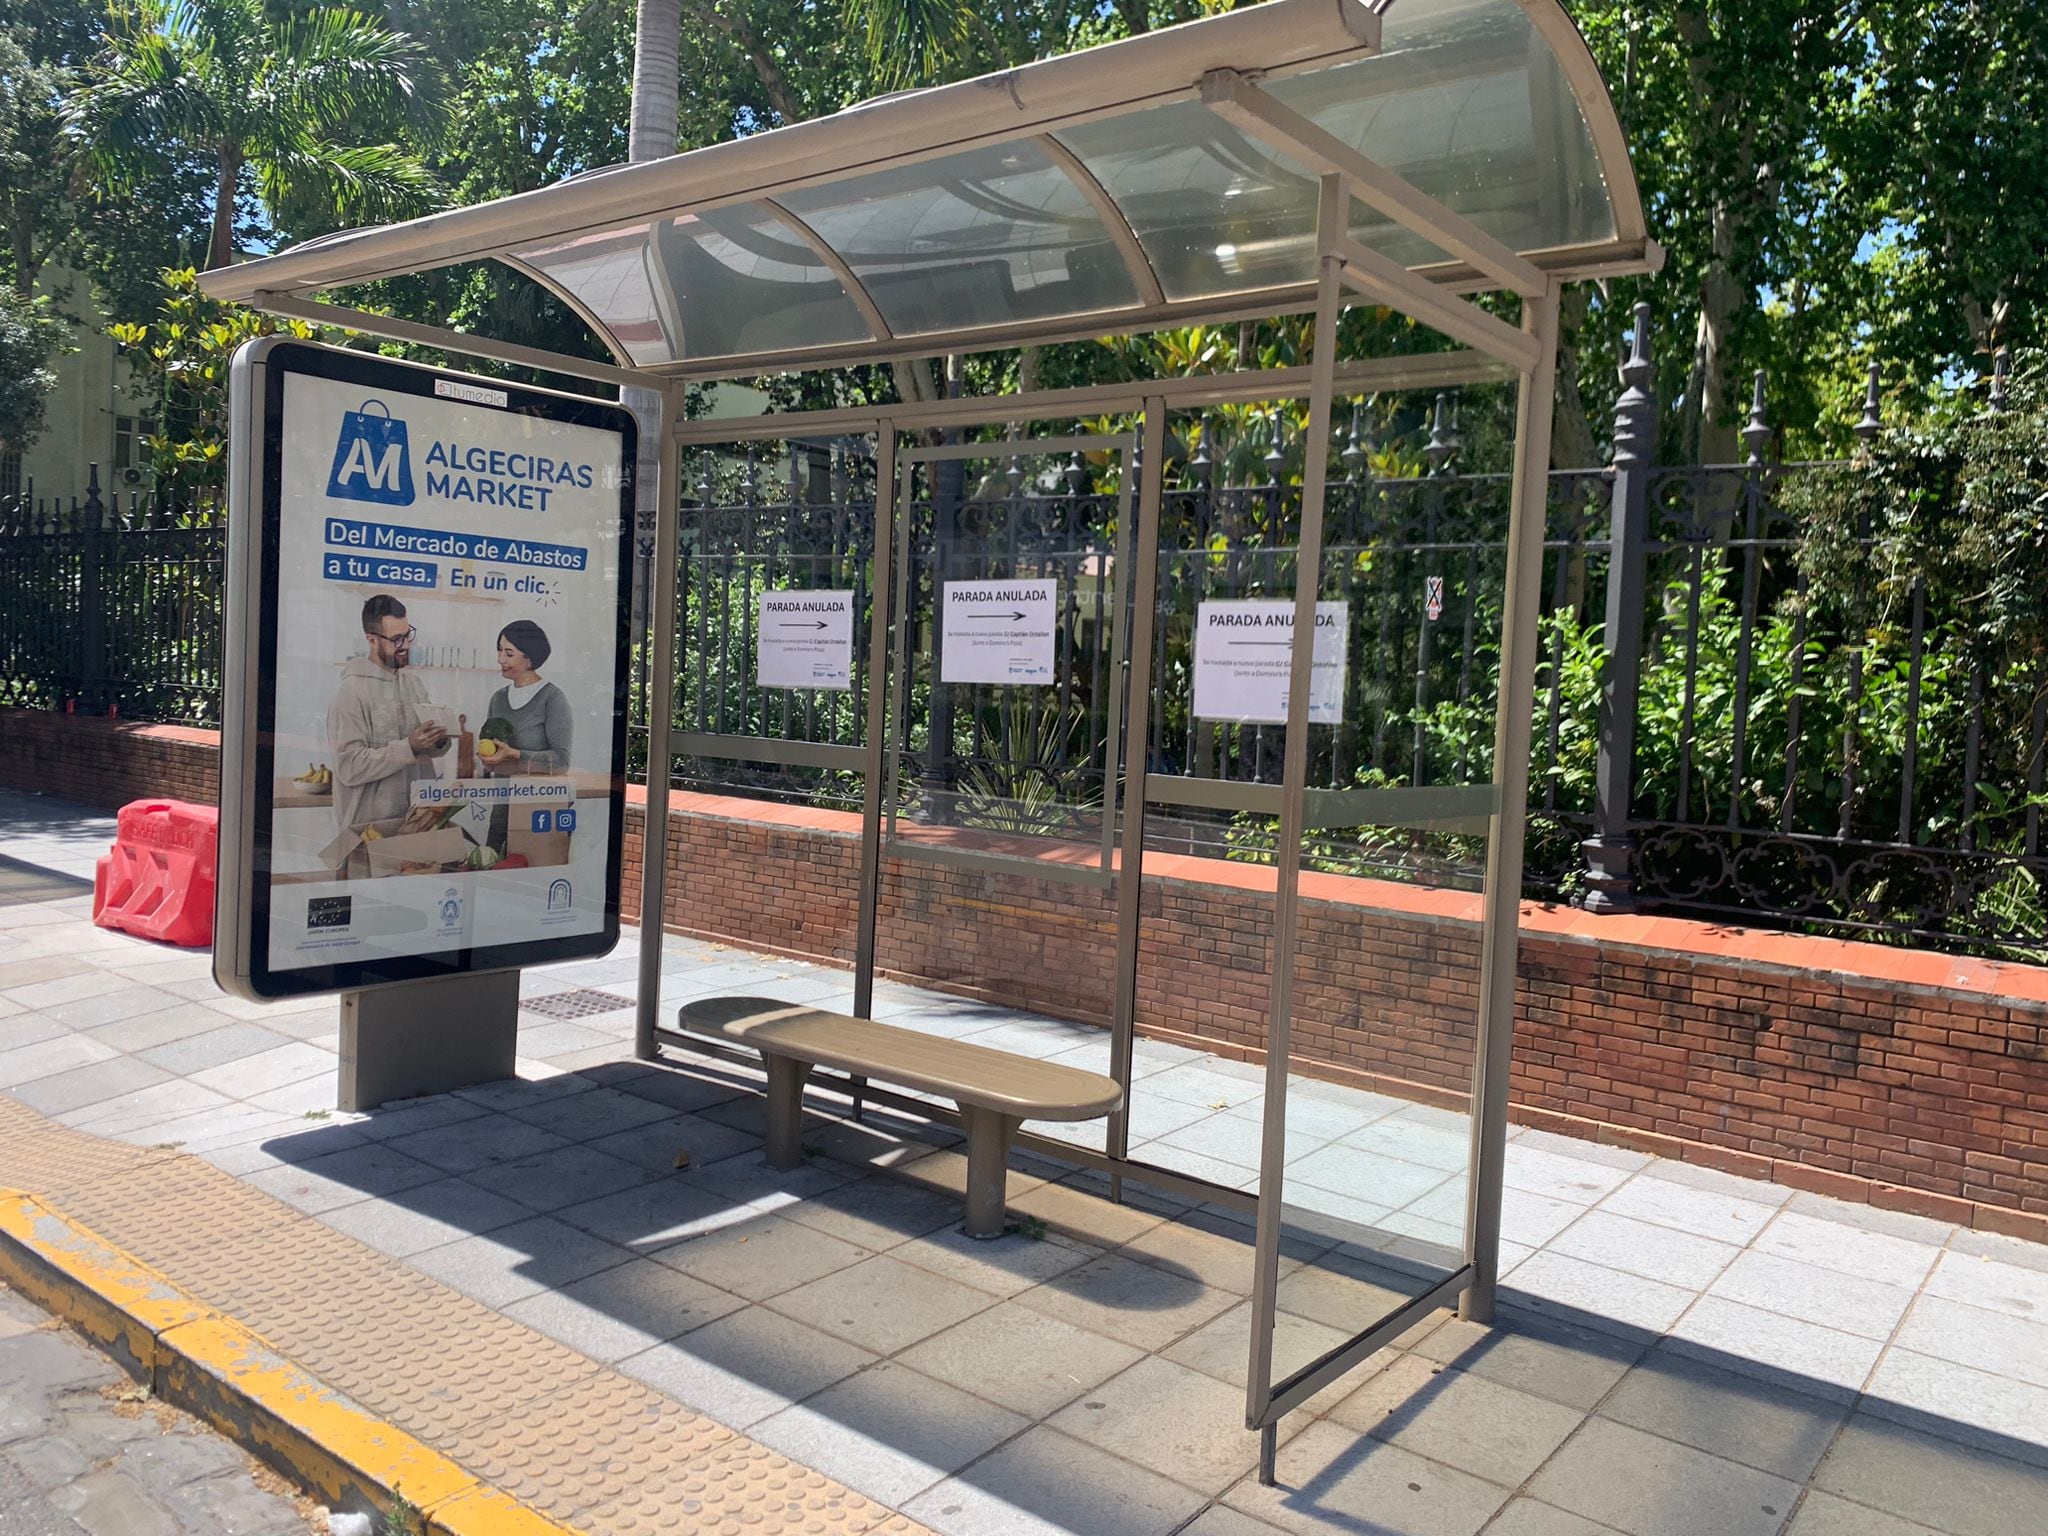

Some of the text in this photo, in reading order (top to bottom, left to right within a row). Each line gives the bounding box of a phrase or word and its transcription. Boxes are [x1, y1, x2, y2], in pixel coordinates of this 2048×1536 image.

[425, 440, 593, 489] ALGECIRAS
[427, 471, 553, 511] MARKET
[330, 521, 582, 568] Del Mercado de Abastos
[328, 557, 550, 594] a tu casa. En un clic.
[767, 602, 845, 612] PARADA ANULADA
[952, 591, 993, 602] PARADA
[995, 590, 1047, 602] ANULADA
[1209, 614, 1334, 627] PARADA ANUDA
[419, 784, 567, 802] algecirasmarket.com
